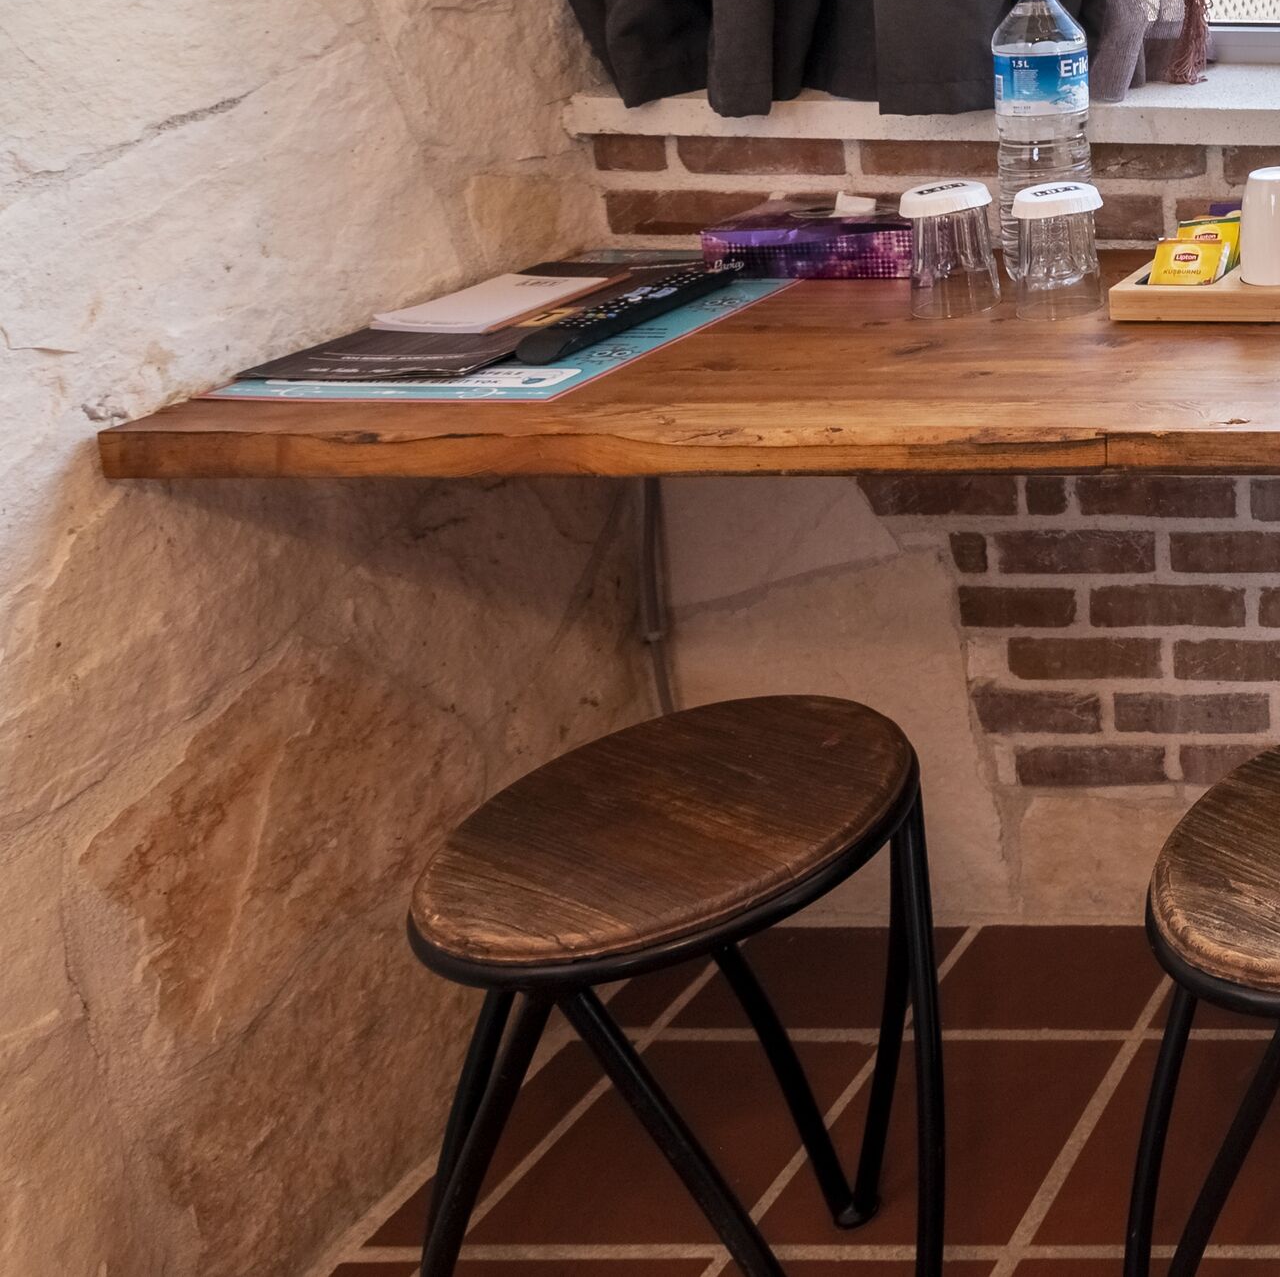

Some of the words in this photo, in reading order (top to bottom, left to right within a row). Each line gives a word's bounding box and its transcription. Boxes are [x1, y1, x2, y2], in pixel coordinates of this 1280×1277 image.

[1060, 58, 1088, 77] Erik
[1175, 254, 1198, 262] Lipton
[1163, 269, 1202, 277] KUŞBURNU
